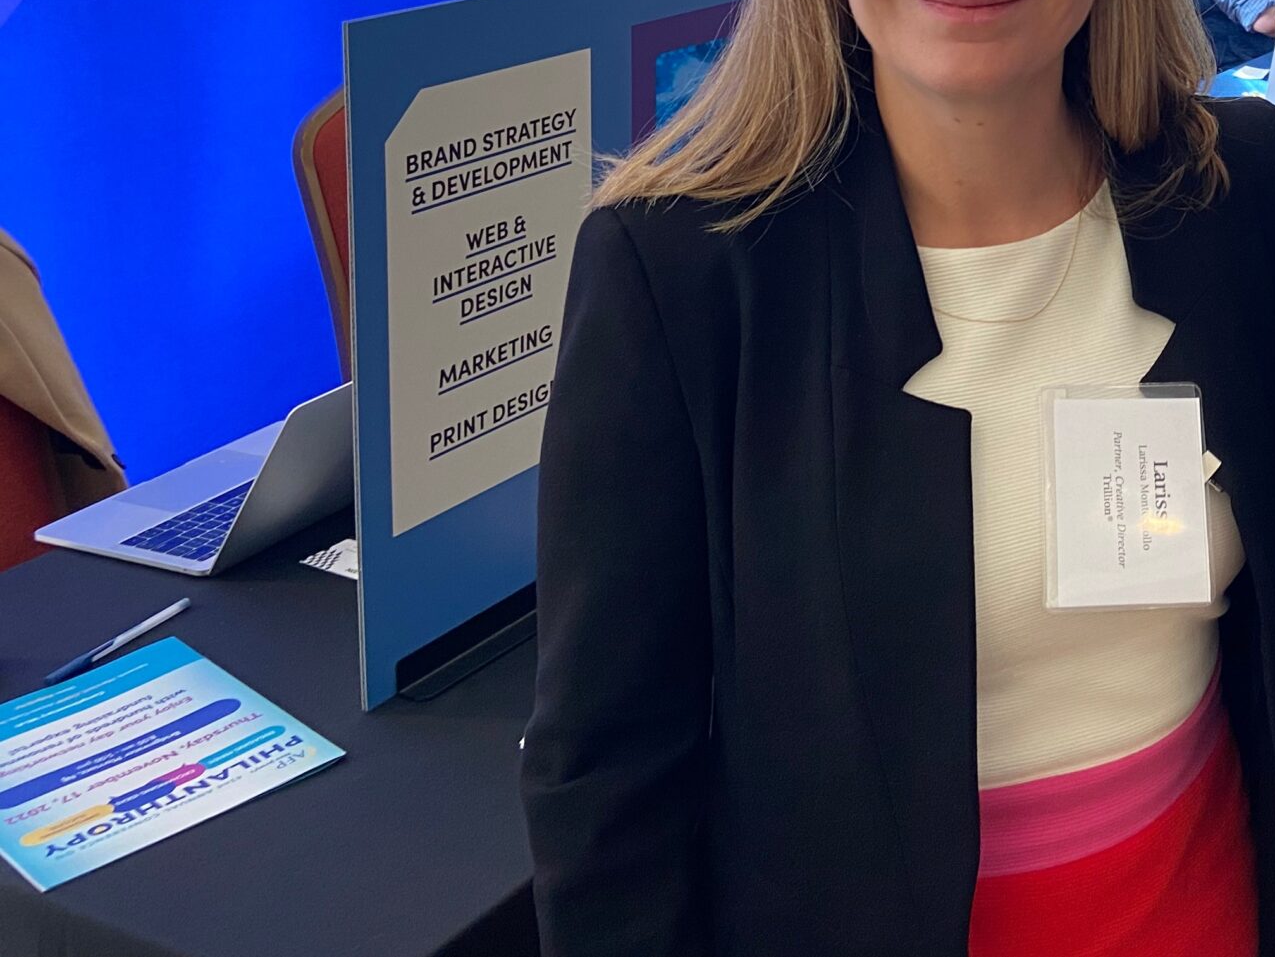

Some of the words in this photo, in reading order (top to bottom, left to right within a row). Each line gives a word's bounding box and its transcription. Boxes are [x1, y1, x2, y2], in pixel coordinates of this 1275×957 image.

[406, 138, 477, 176] BRAND
[482, 108, 577, 152] STRATEGY
[412, 186, 426, 206] &
[432, 141, 573, 202] DEVELOPMENT
[466, 220, 508, 251] WEB
[513, 215, 526, 233] &
[433, 235, 556, 296] INTERACTIVE
[461, 274, 533, 318] DESIGN
[439, 324, 553, 389] MARKETING
[430, 410, 488, 454] PRINT
[493, 380, 553, 423] DESIG
[1113, 431, 1123, 473] Partner,
[1138, 445, 1148, 481] Larissa
[1115, 476, 1125, 520] Creative
[1117, 524, 1127, 569] Director
[74, 695, 153, 729] fundraising
[154, 689, 186, 705] with
[156, 696, 193, 715] Enjoy
[85, 704, 153, 735] hundreds
[90, 731, 115, 743] day
[119, 714, 152, 731] your
[178, 713, 262, 749] Thursday,
[87, 750, 179, 791] November
[278, 750, 304, 769] AFP
[4, 803, 50, 825] 2022
[47, 735, 304, 857] PHILANTHROPY
